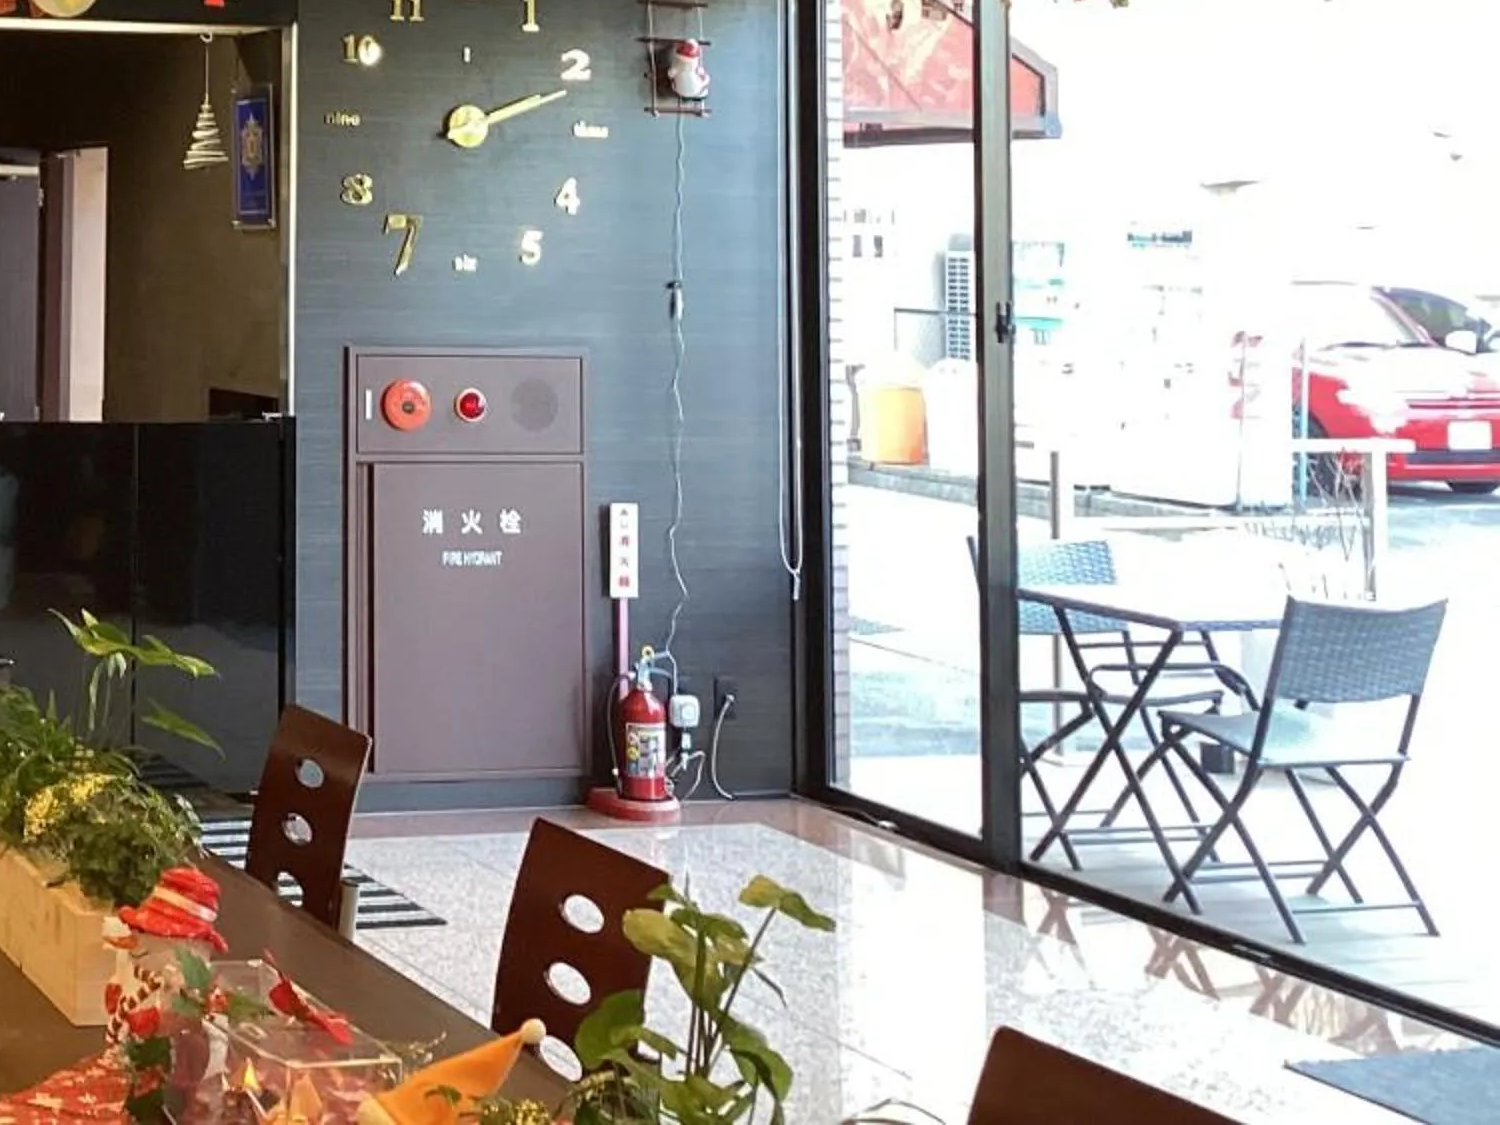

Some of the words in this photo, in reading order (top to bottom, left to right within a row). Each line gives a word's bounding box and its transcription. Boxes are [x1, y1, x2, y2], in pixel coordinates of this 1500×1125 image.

[342, 35, 382, 67] 10
[560, 49, 593, 81] 2
[325, 112, 360, 126] nine
[340, 174, 374, 206] 8
[554, 177, 582, 216] 4
[383, 213, 424, 276] 7
[519, 229, 545, 266] 5
[422, 508, 522, 535] 消火栓
